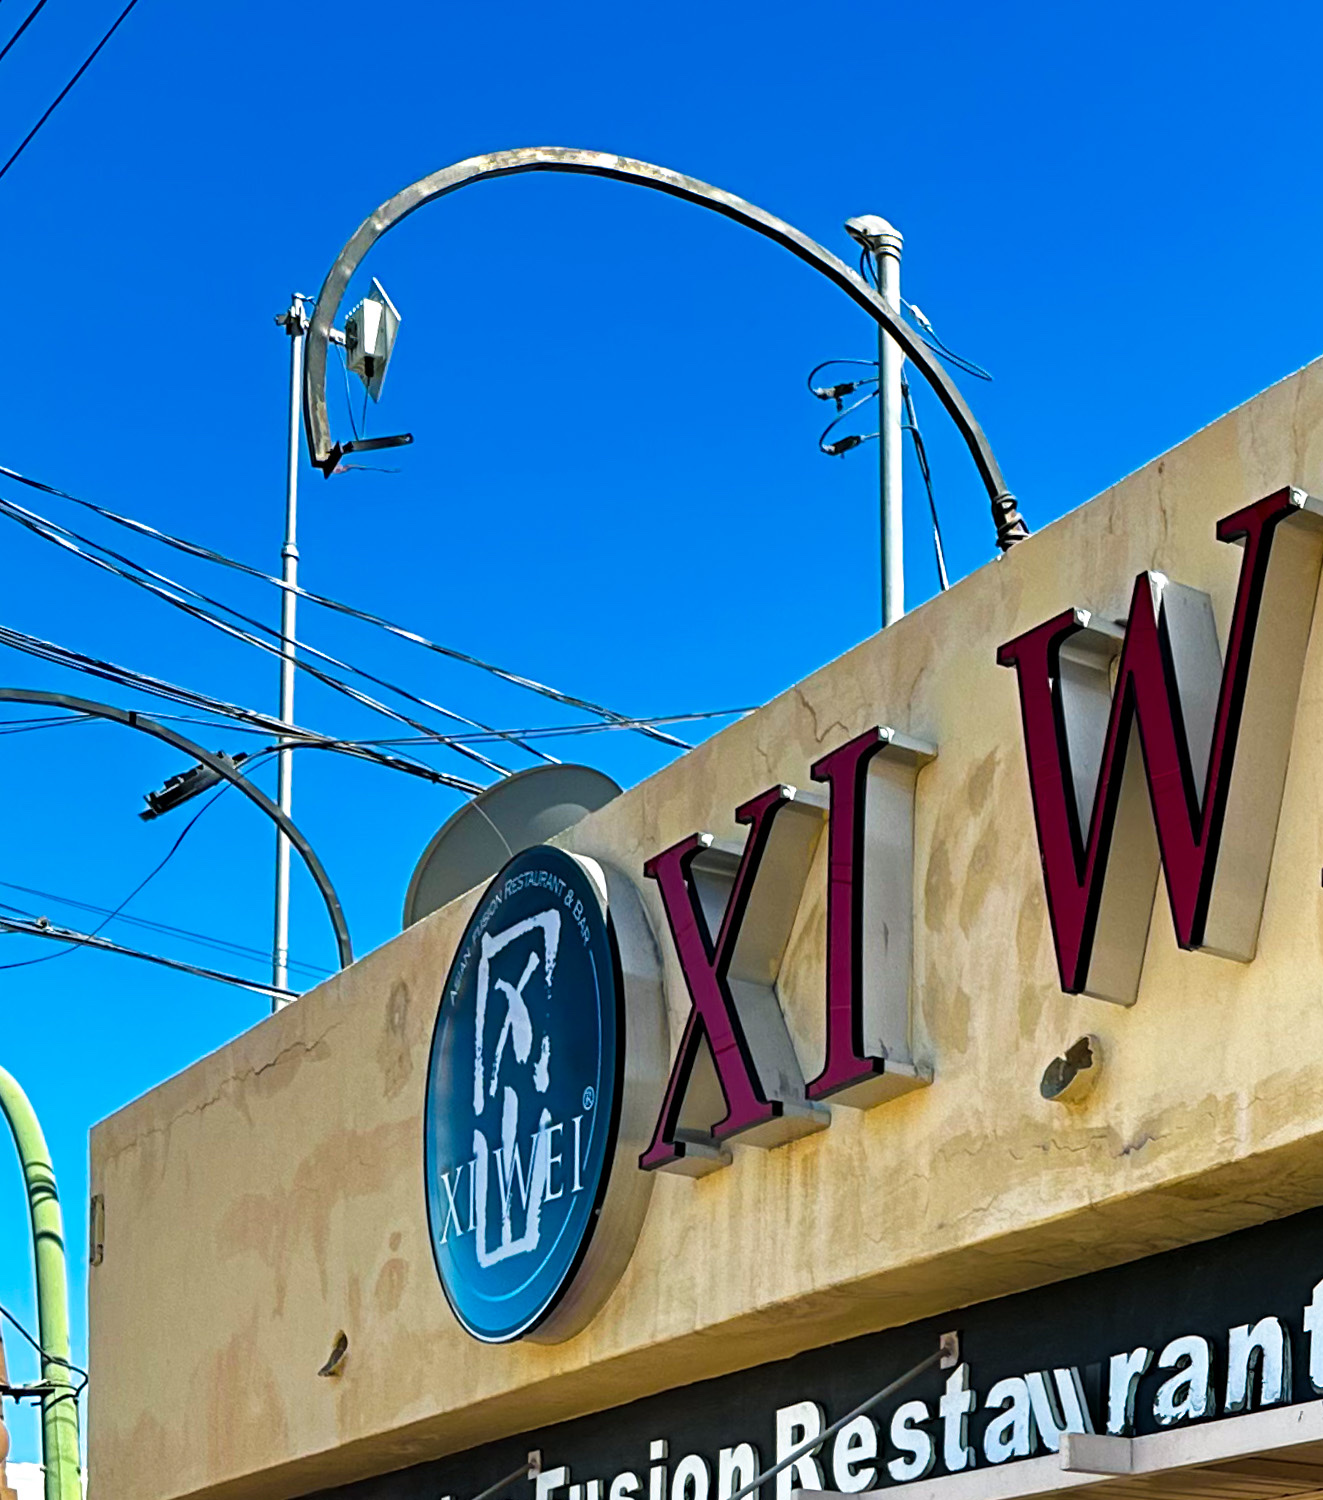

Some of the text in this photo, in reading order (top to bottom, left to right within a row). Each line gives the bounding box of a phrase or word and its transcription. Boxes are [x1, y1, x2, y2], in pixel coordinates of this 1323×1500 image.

[504, 870, 567, 900] RESTAURANT
[564, 889, 575, 909] &
[572, 899, 591, 947] BAR
[638, 725, 895, 1172] XI
[440, 1115, 584, 1245] XI WEI
